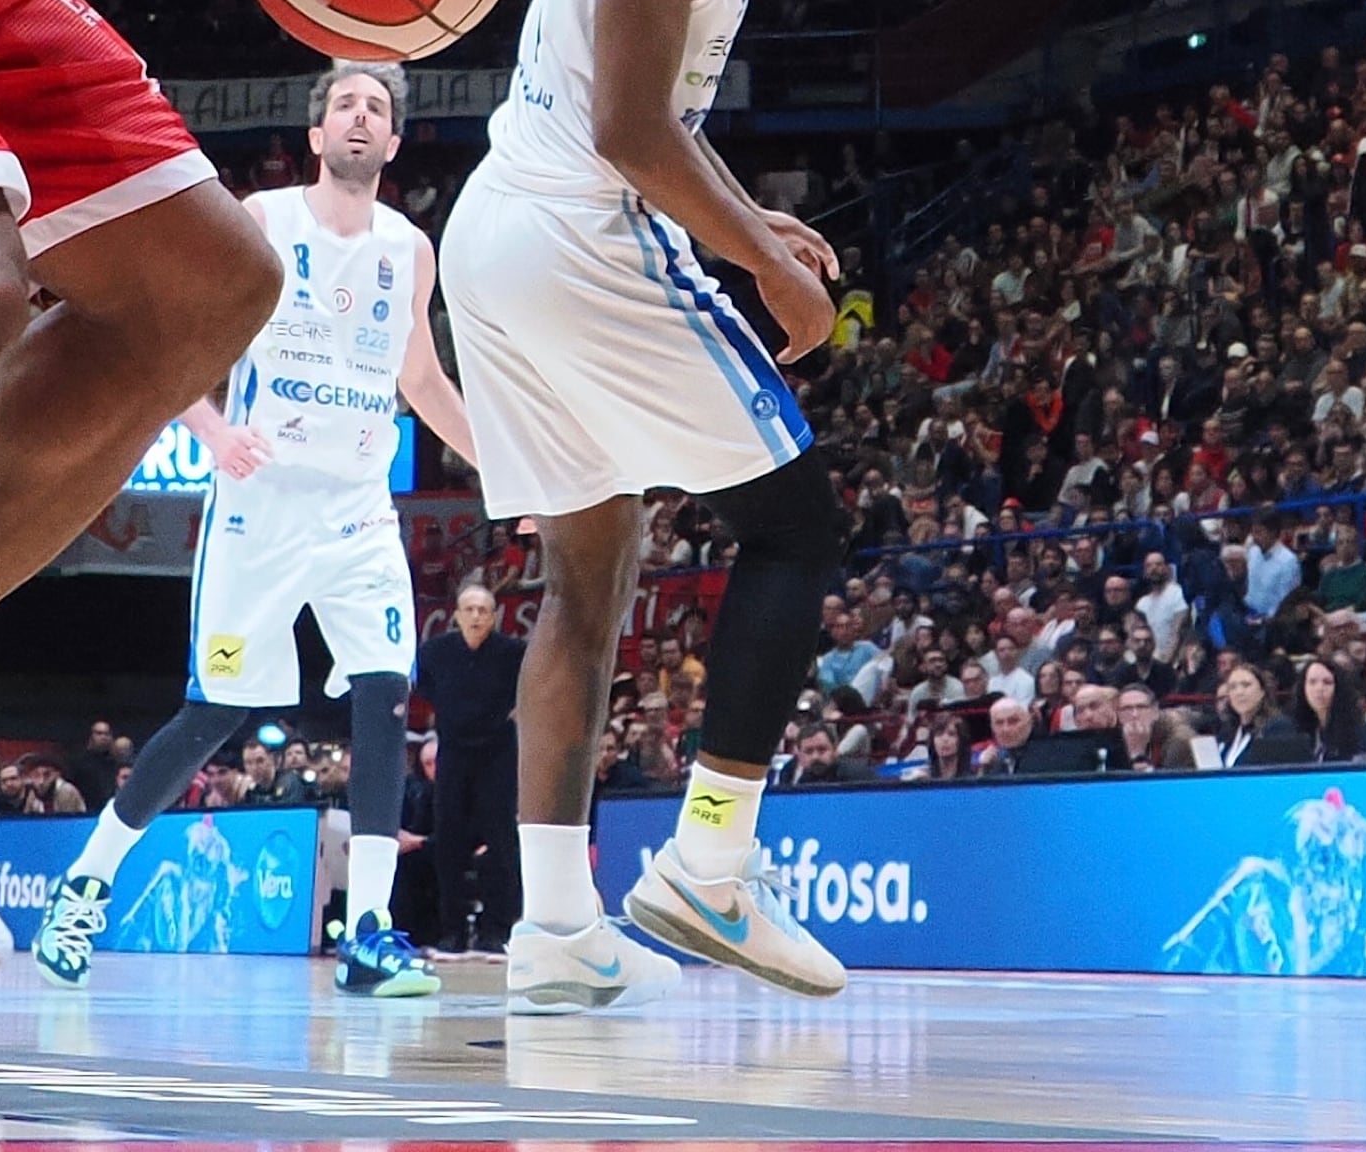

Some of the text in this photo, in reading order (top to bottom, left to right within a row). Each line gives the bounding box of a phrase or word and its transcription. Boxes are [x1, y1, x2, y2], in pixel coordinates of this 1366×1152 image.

[385, 607, 400, 644] 8
[691, 807, 723, 824] PRS
[258, 869, 293, 900] Vera
